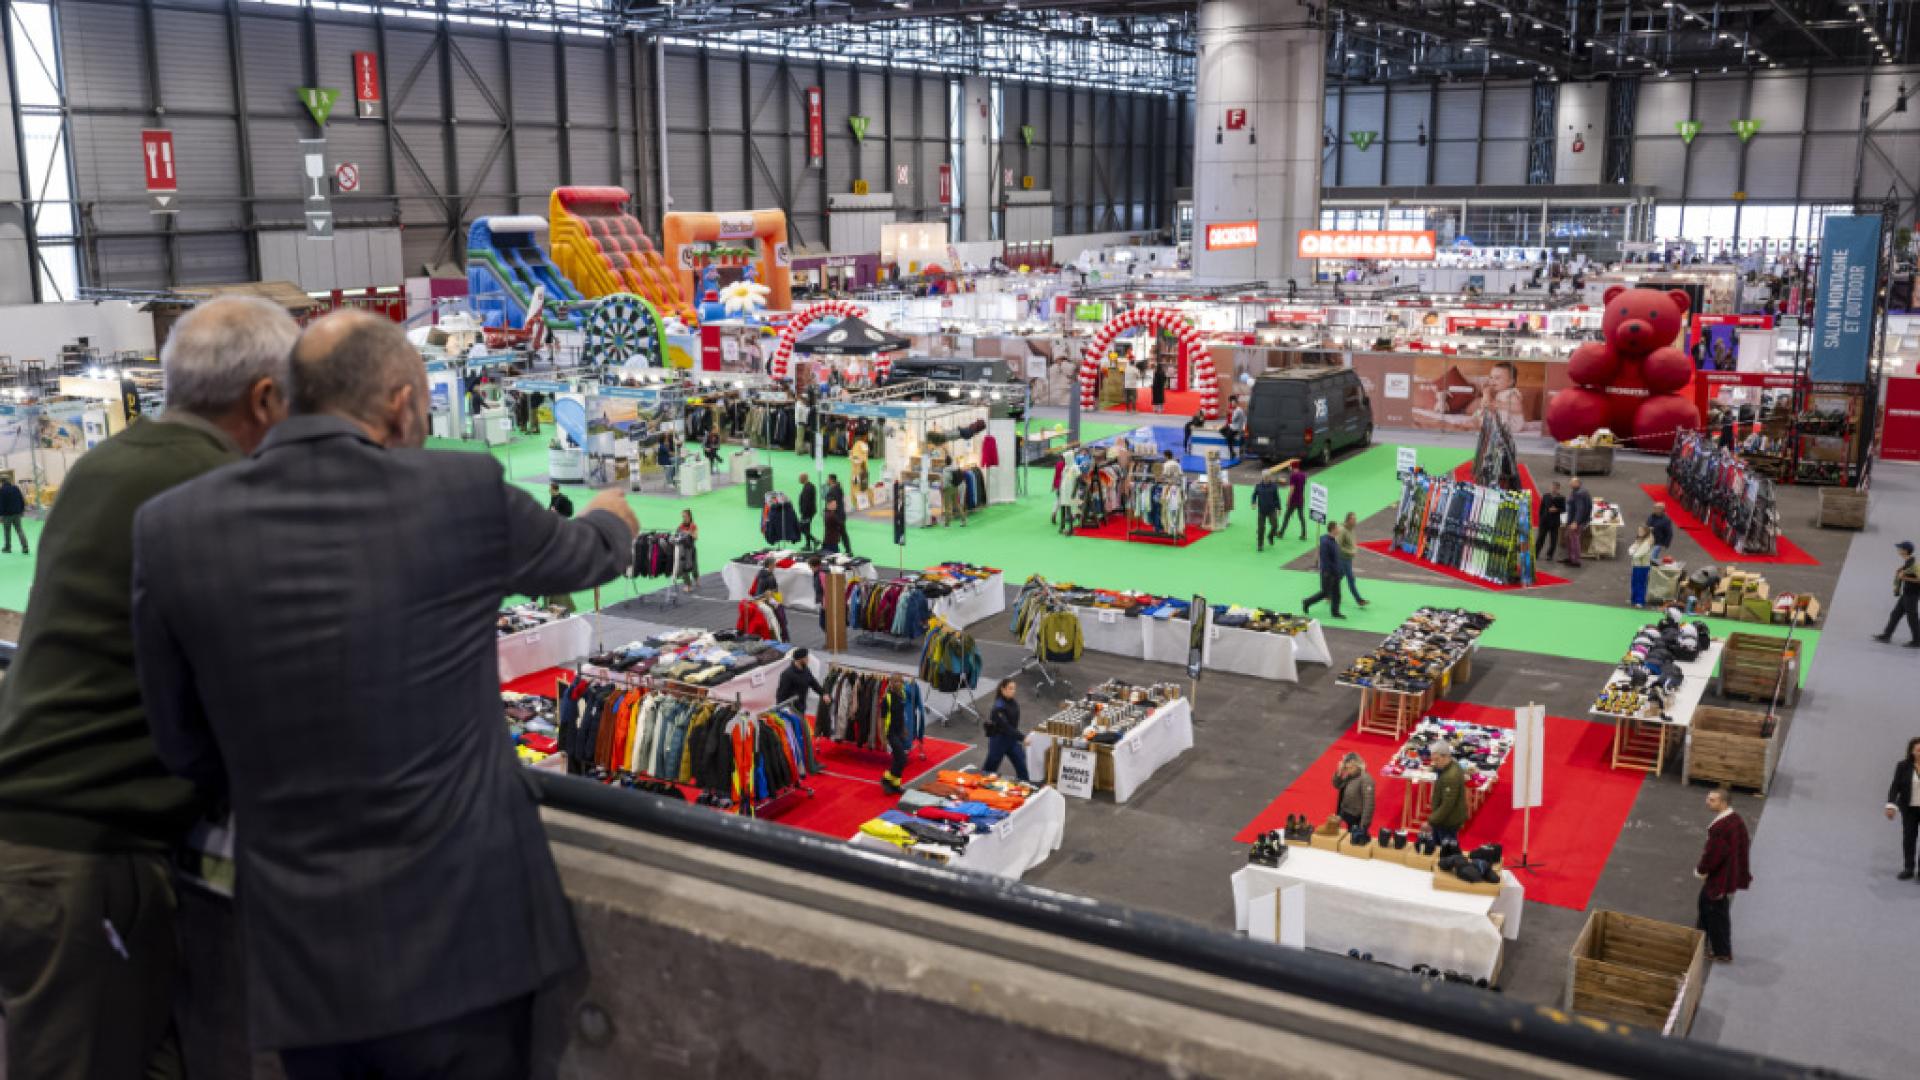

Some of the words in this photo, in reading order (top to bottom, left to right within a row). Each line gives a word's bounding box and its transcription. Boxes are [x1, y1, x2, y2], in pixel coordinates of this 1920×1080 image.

[1231, 112, 1242, 124] F
[1301, 235, 1433, 254] ORCHESTRA
[1828, 249, 1848, 308] MONTAGNE
[1845, 266, 1865, 317] OUTDOOR
[1824, 313, 1842, 348] SALON
[1844, 319, 1859, 333] ET
